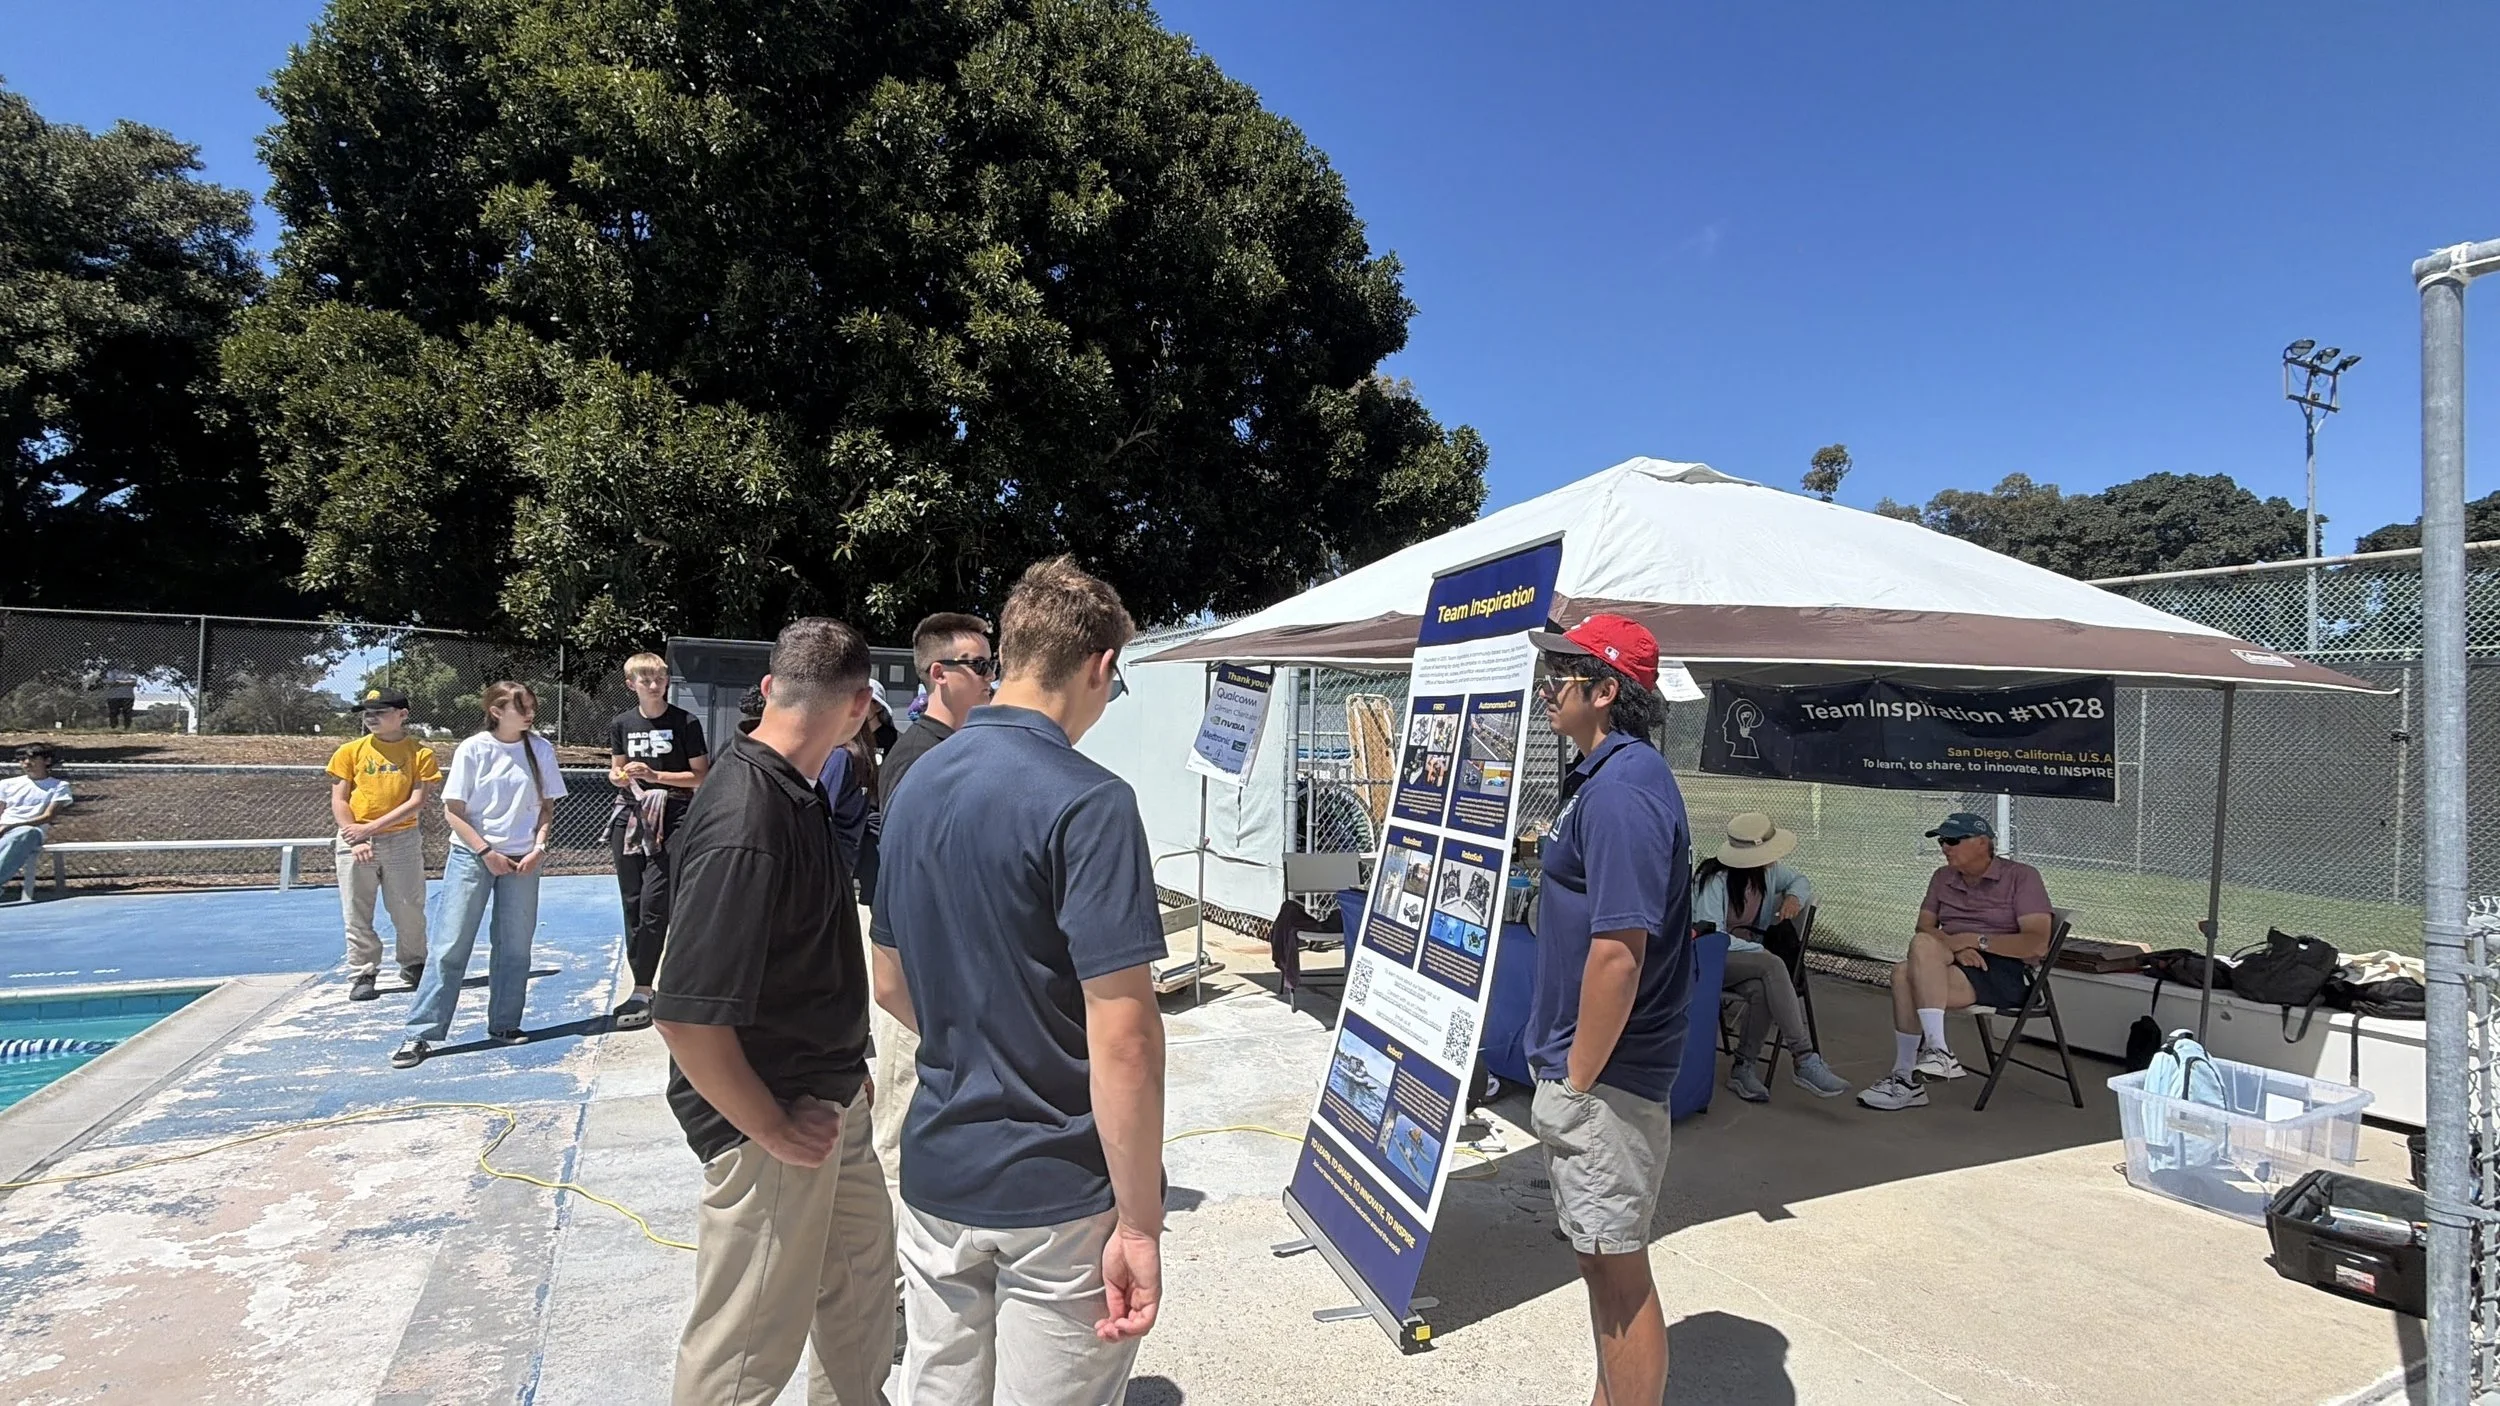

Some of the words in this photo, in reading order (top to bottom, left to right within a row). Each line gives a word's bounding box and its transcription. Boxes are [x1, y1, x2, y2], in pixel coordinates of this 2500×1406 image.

[1438, 603, 1468, 623] Team
[1469, 585, 1535, 618] Inspiration
[1228, 671, 1250, 685] Thank
[1250, 679, 1266, 688] you
[1217, 687, 1258, 707] Qualcomm
[1801, 701, 1865, 720] Team
[1869, 698, 2005, 724] Inspiration
[2008, 697, 2105, 723] #11128
[1947, 747, 1970, 757] San
[1974, 747, 2012, 760] Diego,
[2015, 749, 2076, 763] California,
[1862, 758, 1875, 768] To
[1876, 759, 1906, 771] learn,
[1909, 760, 1923, 770] to
[1926, 760, 1965, 772] share,
[1968, 761, 1981, 771] to
[1984, 761, 2041, 775] innovate,
[2043, 765, 2057, 776] to
[2060, 766, 2115, 779] INSPIRE
[1311, 1137, 1318, 1149] TO
[1331, 1157, 1338, 1169] TO
[1352, 1179, 1360, 1192] TO
[1359, 1186, 1386, 1220] INNOVATE,
[1385, 1211, 1394, 1226] TO
[1392, 1220, 1416, 1249] INSPIRE
